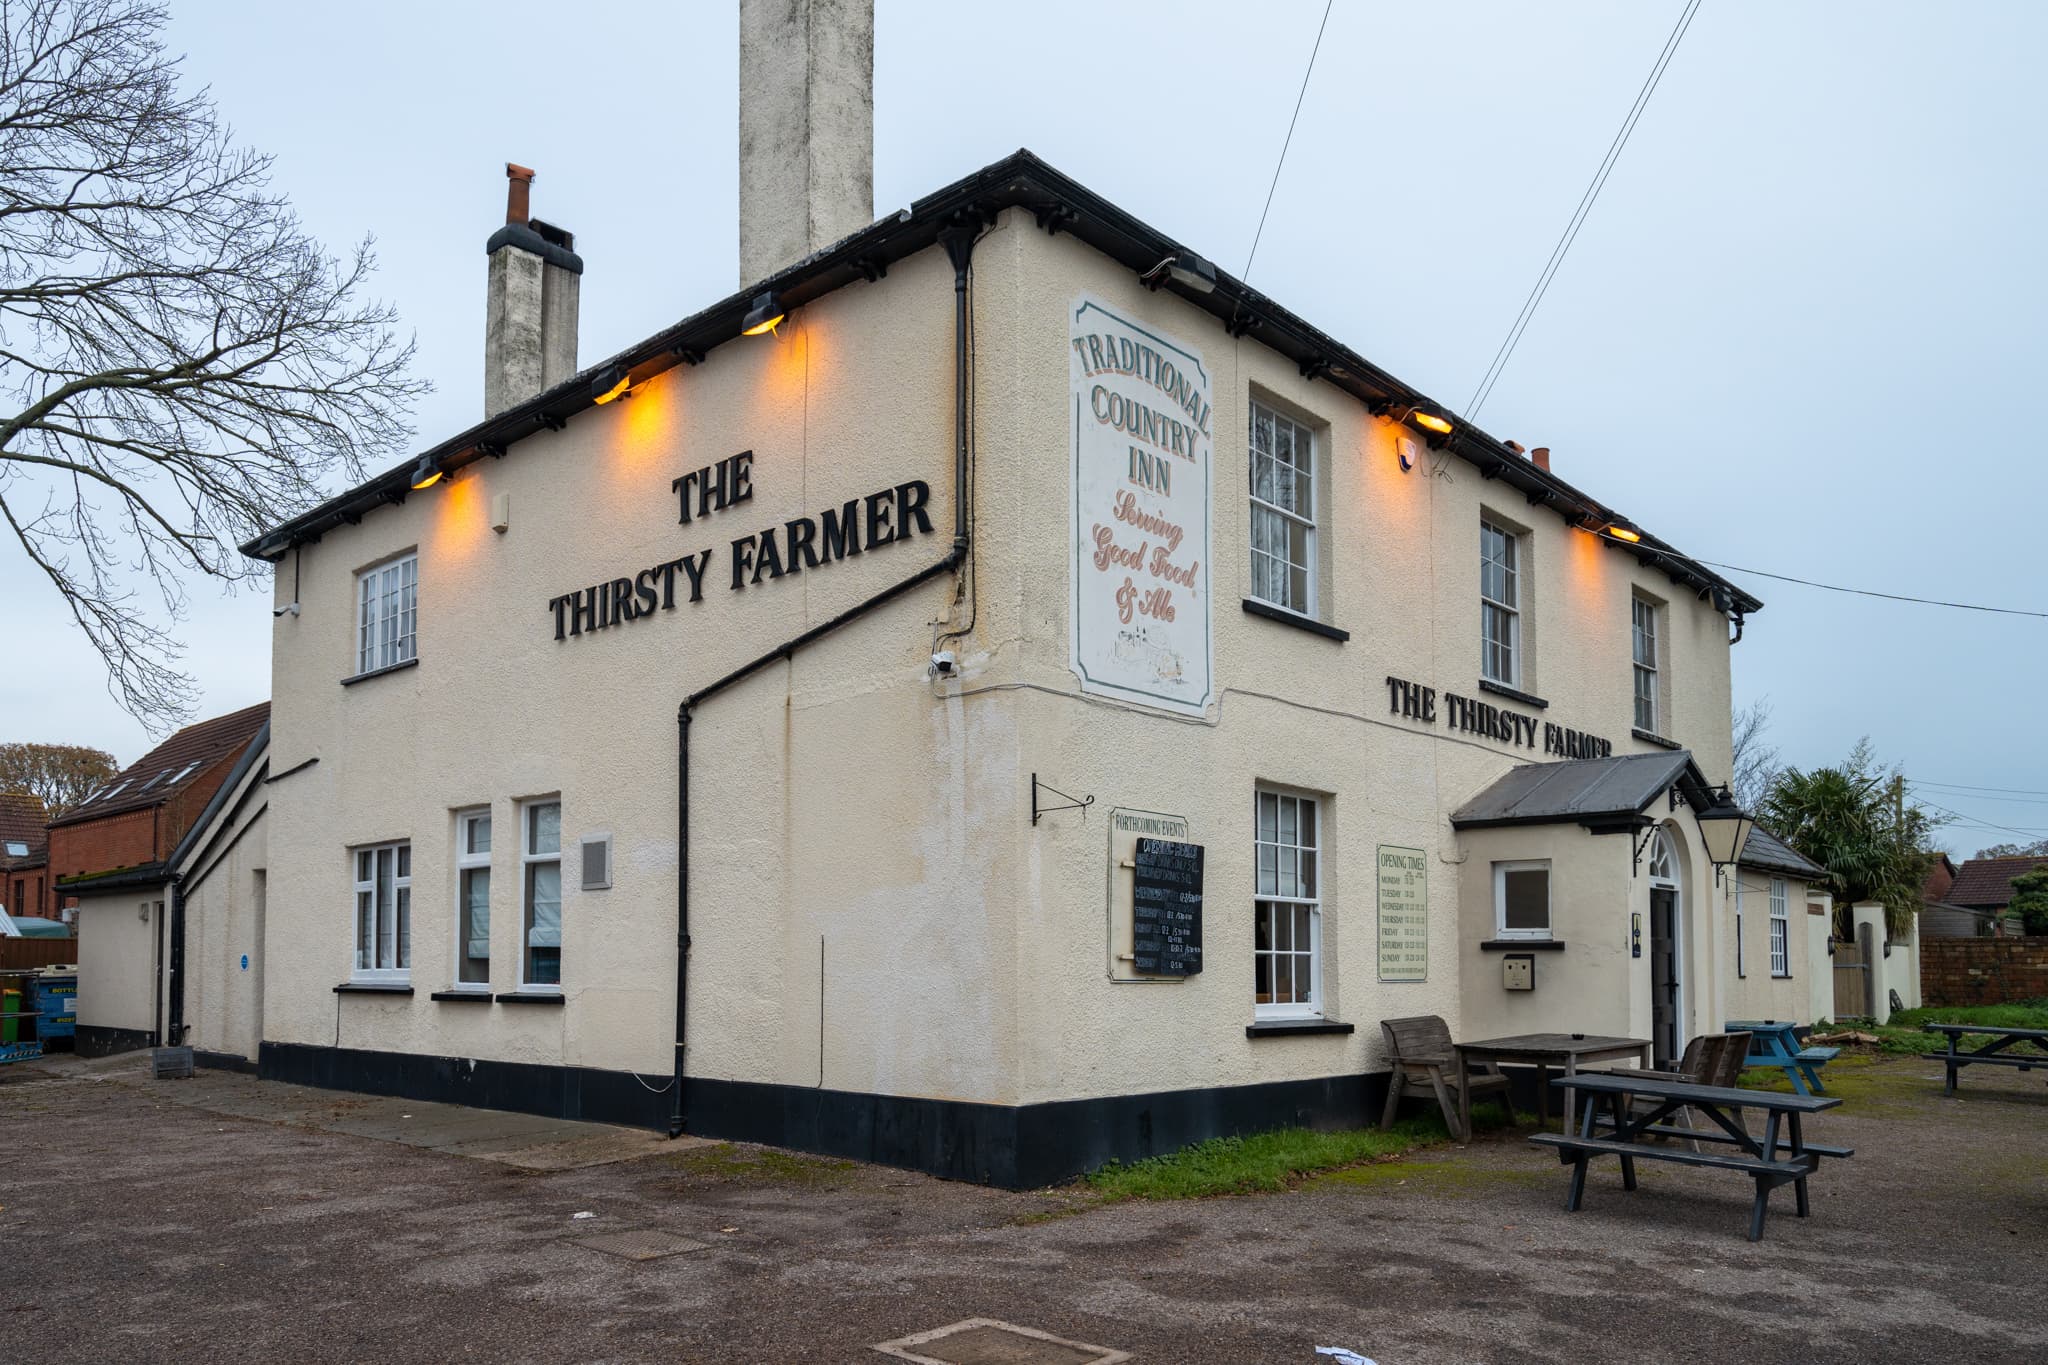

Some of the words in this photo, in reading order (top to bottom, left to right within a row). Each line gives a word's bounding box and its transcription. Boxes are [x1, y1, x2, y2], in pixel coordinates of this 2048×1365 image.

[1072, 334, 1211, 440] TRADITIONAL
[1091, 384, 1199, 464] COUNTRY
[672, 450, 753, 525] THE
[1128, 446, 1171, 497] INN
[1113, 488, 1184, 551] Serving
[549, 549, 712, 641] THIRSTY
[730, 480, 935, 590] FARMER
[1092, 523, 1148, 572] Good
[1149, 546, 1199, 588] Food
[1116, 576, 1138, 624] &
[1138, 587, 1176, 623] Ale
[1386, 676, 1436, 722] THE
[1445, 692, 1539, 748] THIRSTY
[1544, 721, 1612, 760] FARMER
[1115, 815, 1161, 835] FORTHCOMING
[1162, 820, 1184, 838] EVENTS
[1381, 853, 1406, 869] OPENING
[1408, 856, 1424, 870] TIMES
